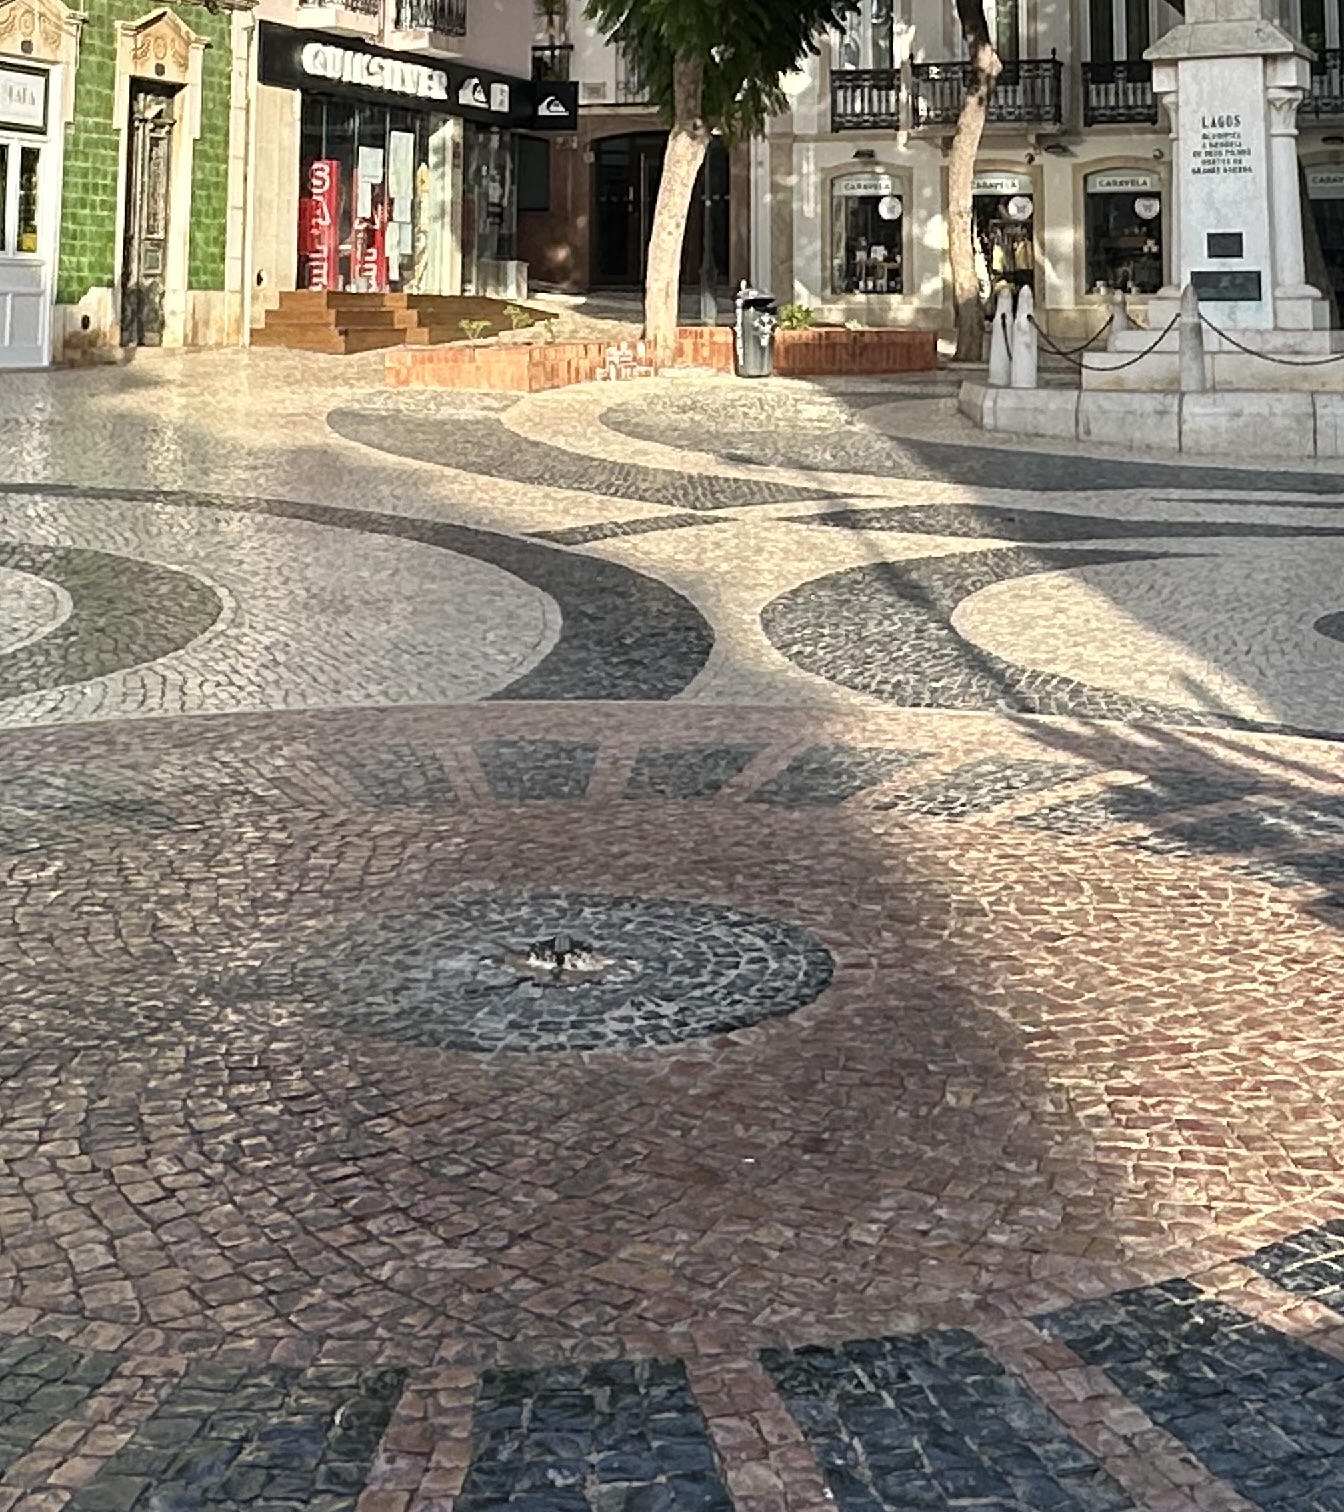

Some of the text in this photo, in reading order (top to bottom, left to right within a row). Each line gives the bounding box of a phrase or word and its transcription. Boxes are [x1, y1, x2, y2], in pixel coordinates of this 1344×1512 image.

[302, 42, 448, 100] QUIKSILVER
[1201, 114, 1242, 129] LAGOS
[1098, 178, 1148, 187] CARAVELA
